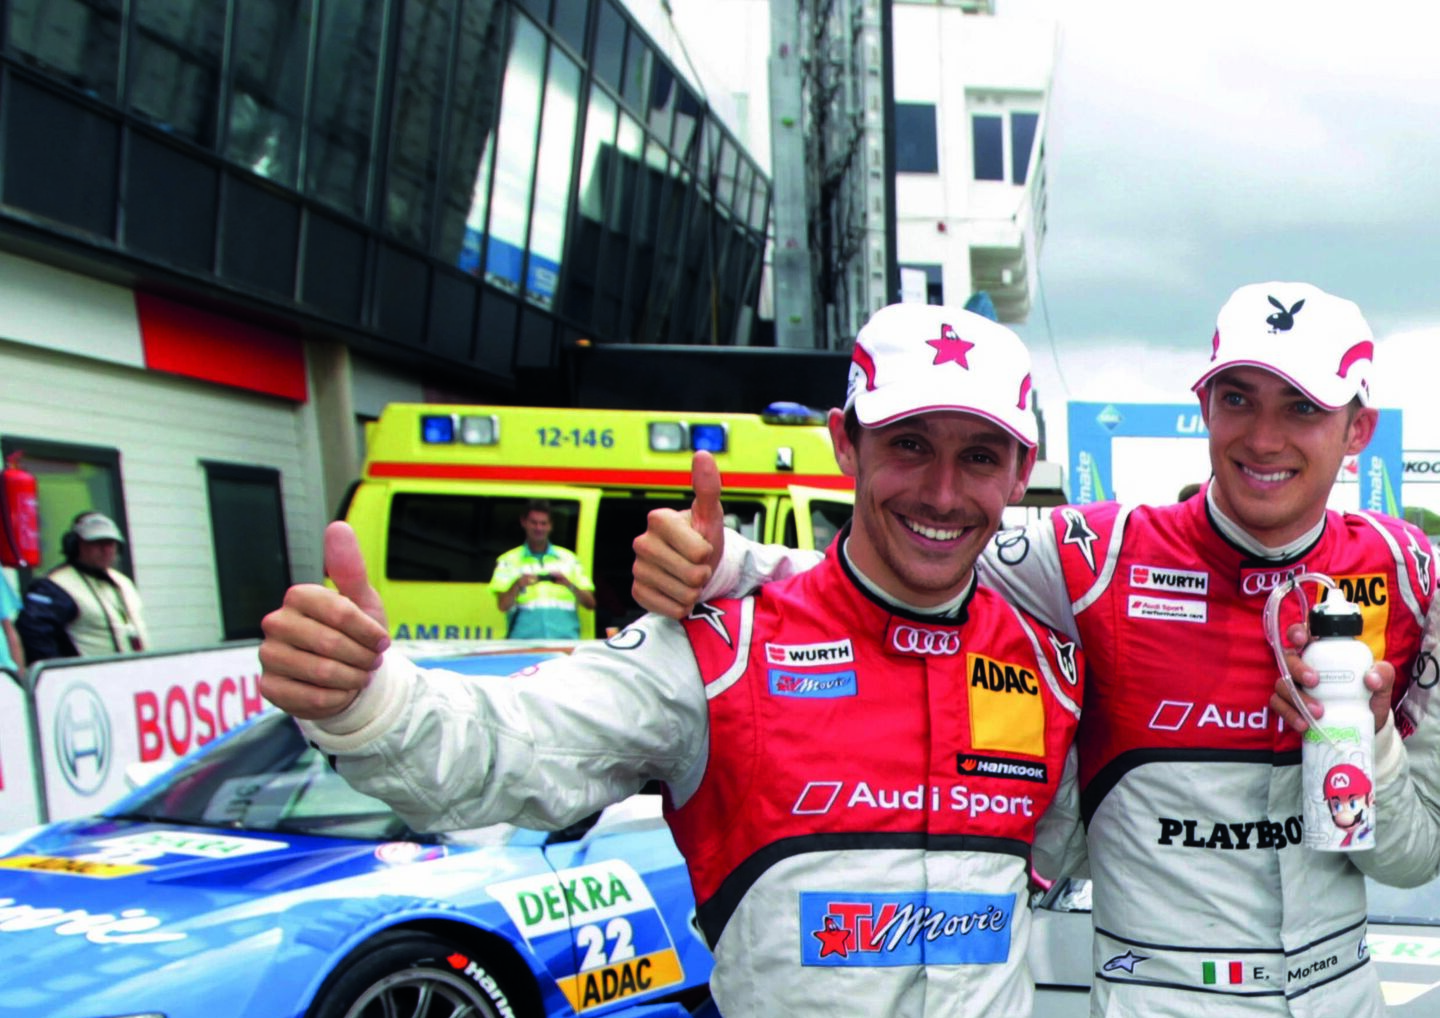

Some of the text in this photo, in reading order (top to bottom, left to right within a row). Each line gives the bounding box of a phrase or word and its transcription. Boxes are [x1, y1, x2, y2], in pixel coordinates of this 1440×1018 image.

[535, 426, 615, 449] 12-146
[971, 657, 1039, 696] ADAC
[134, 673, 263, 763] BOSCH
[847, 783, 1033, 817] Audi Sport
[1158, 815, 1302, 850] PLAYBO
[517, 872, 632, 926] DEKRA
[577, 917, 635, 972] 22
[828, 903, 1008, 952] TV Movie
[583, 958, 652, 1007] ADAC
[1254, 954, 1339, 983] E. Mortara
